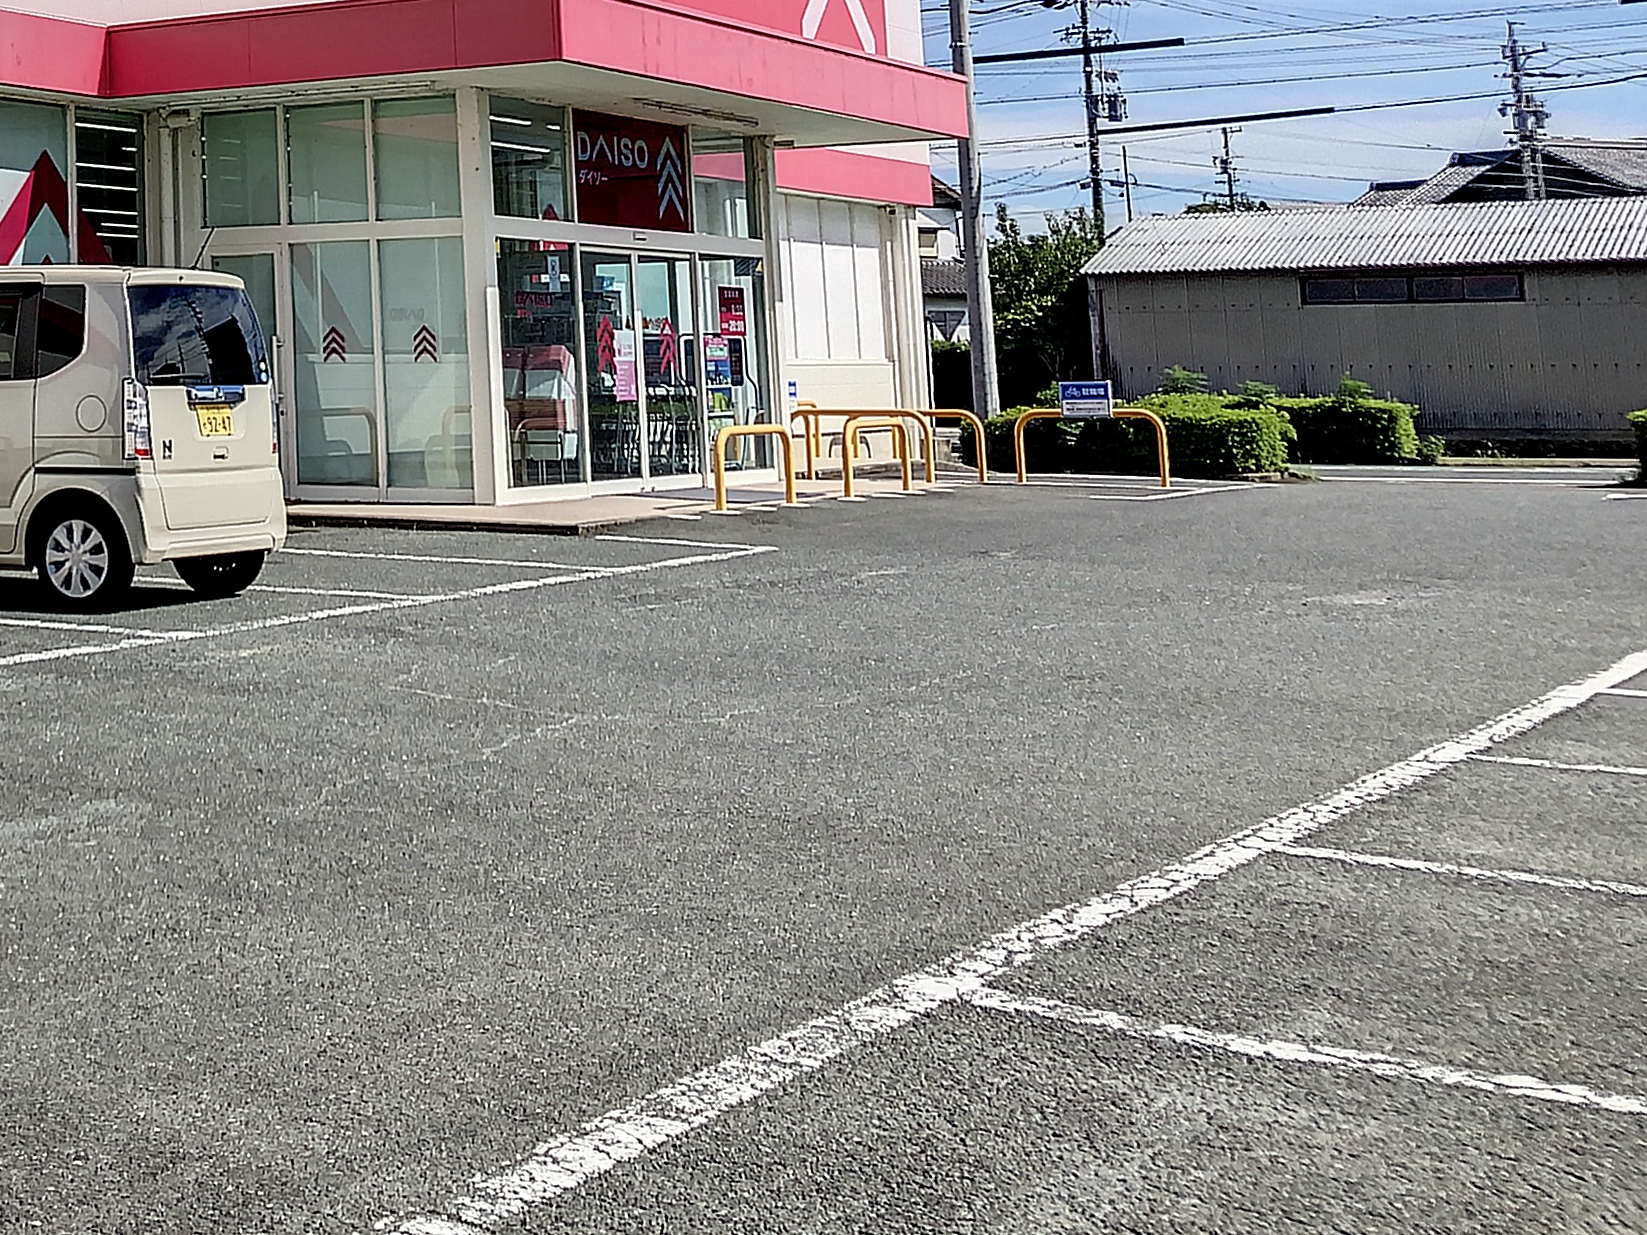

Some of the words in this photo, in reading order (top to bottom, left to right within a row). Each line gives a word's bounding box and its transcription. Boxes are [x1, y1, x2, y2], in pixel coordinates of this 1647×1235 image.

[577, 131, 649, 169] DAISO
[579, 168, 609, 186] ダイソー
